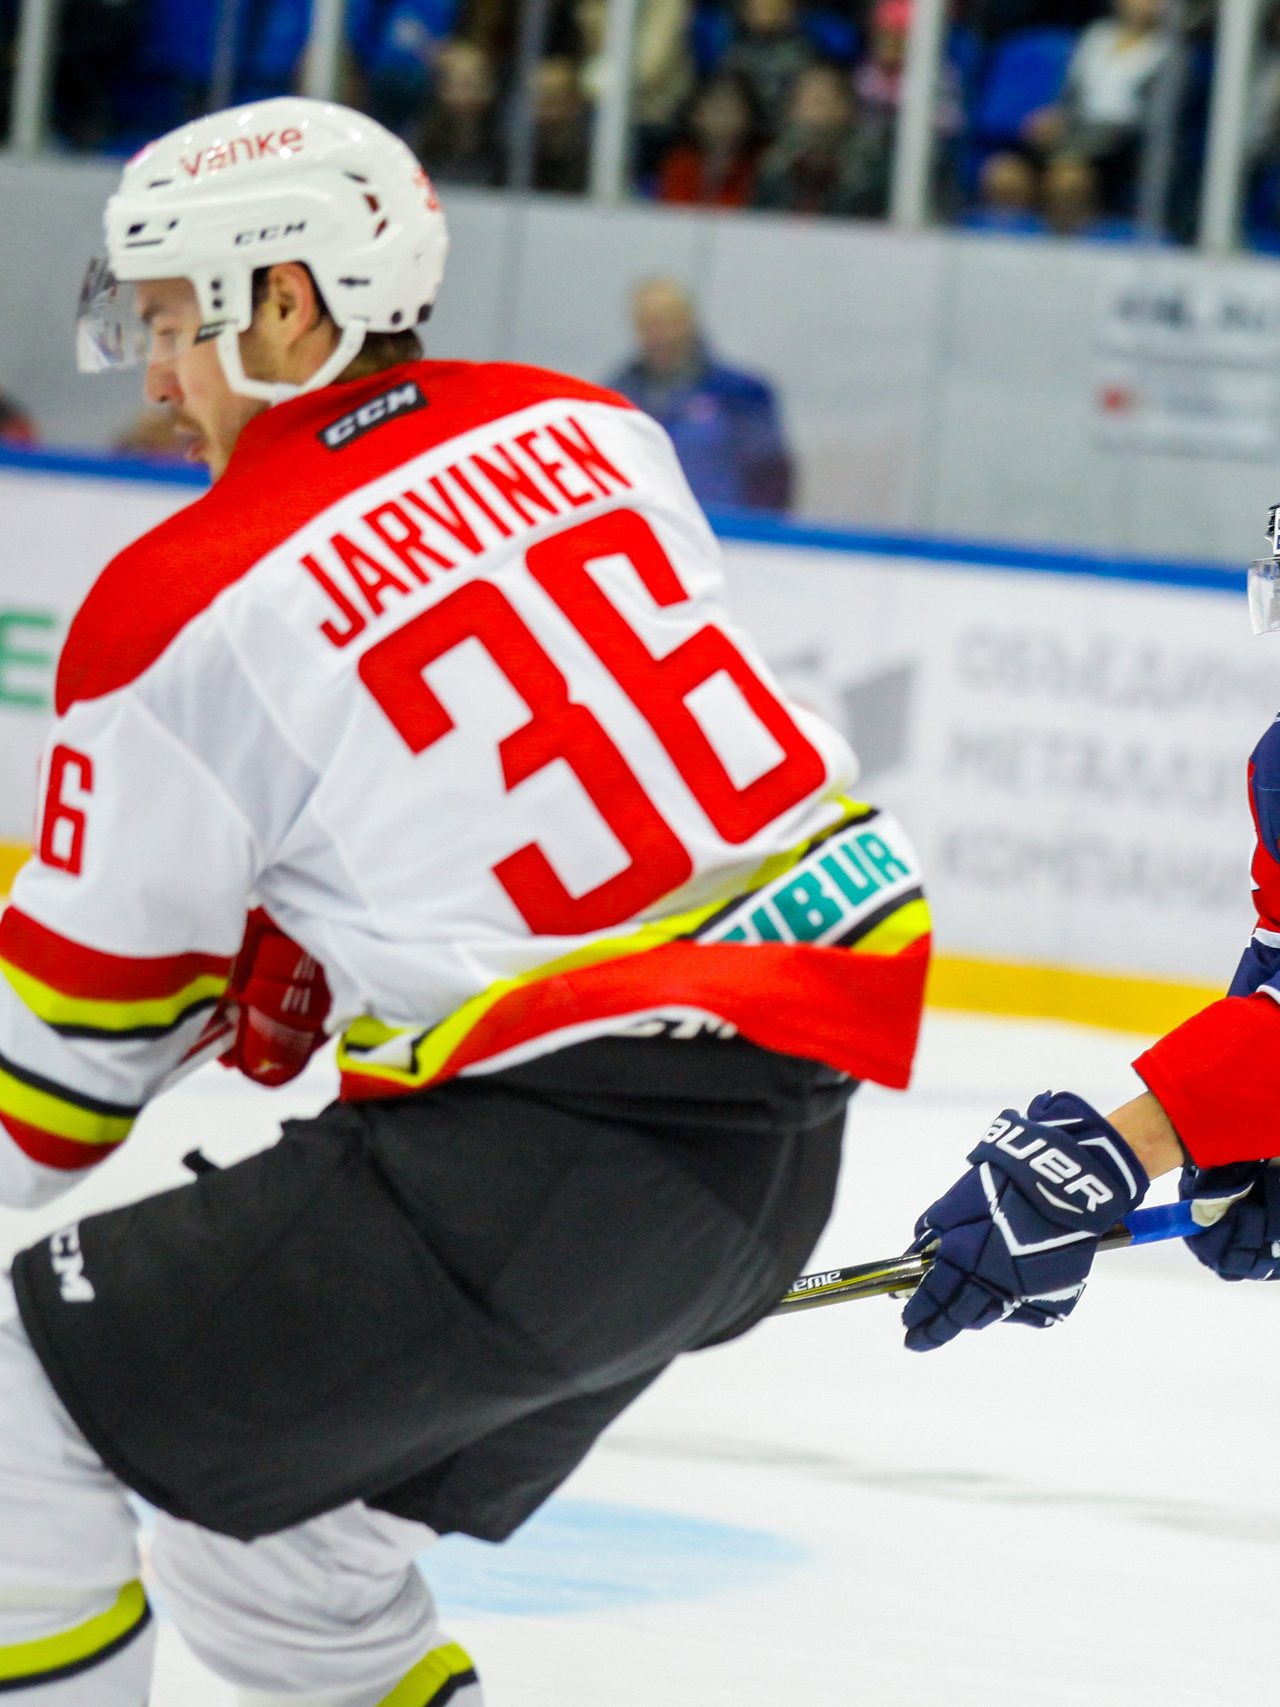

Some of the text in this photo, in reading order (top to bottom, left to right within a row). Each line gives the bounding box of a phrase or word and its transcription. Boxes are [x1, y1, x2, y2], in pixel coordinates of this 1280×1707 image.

[234, 220, 307, 246] CCM
[325, 385, 418, 449] CCM
[299, 416, 634, 650] JARVINEN
[357, 508, 828, 937] 36
[34, 743, 93, 878] 6
